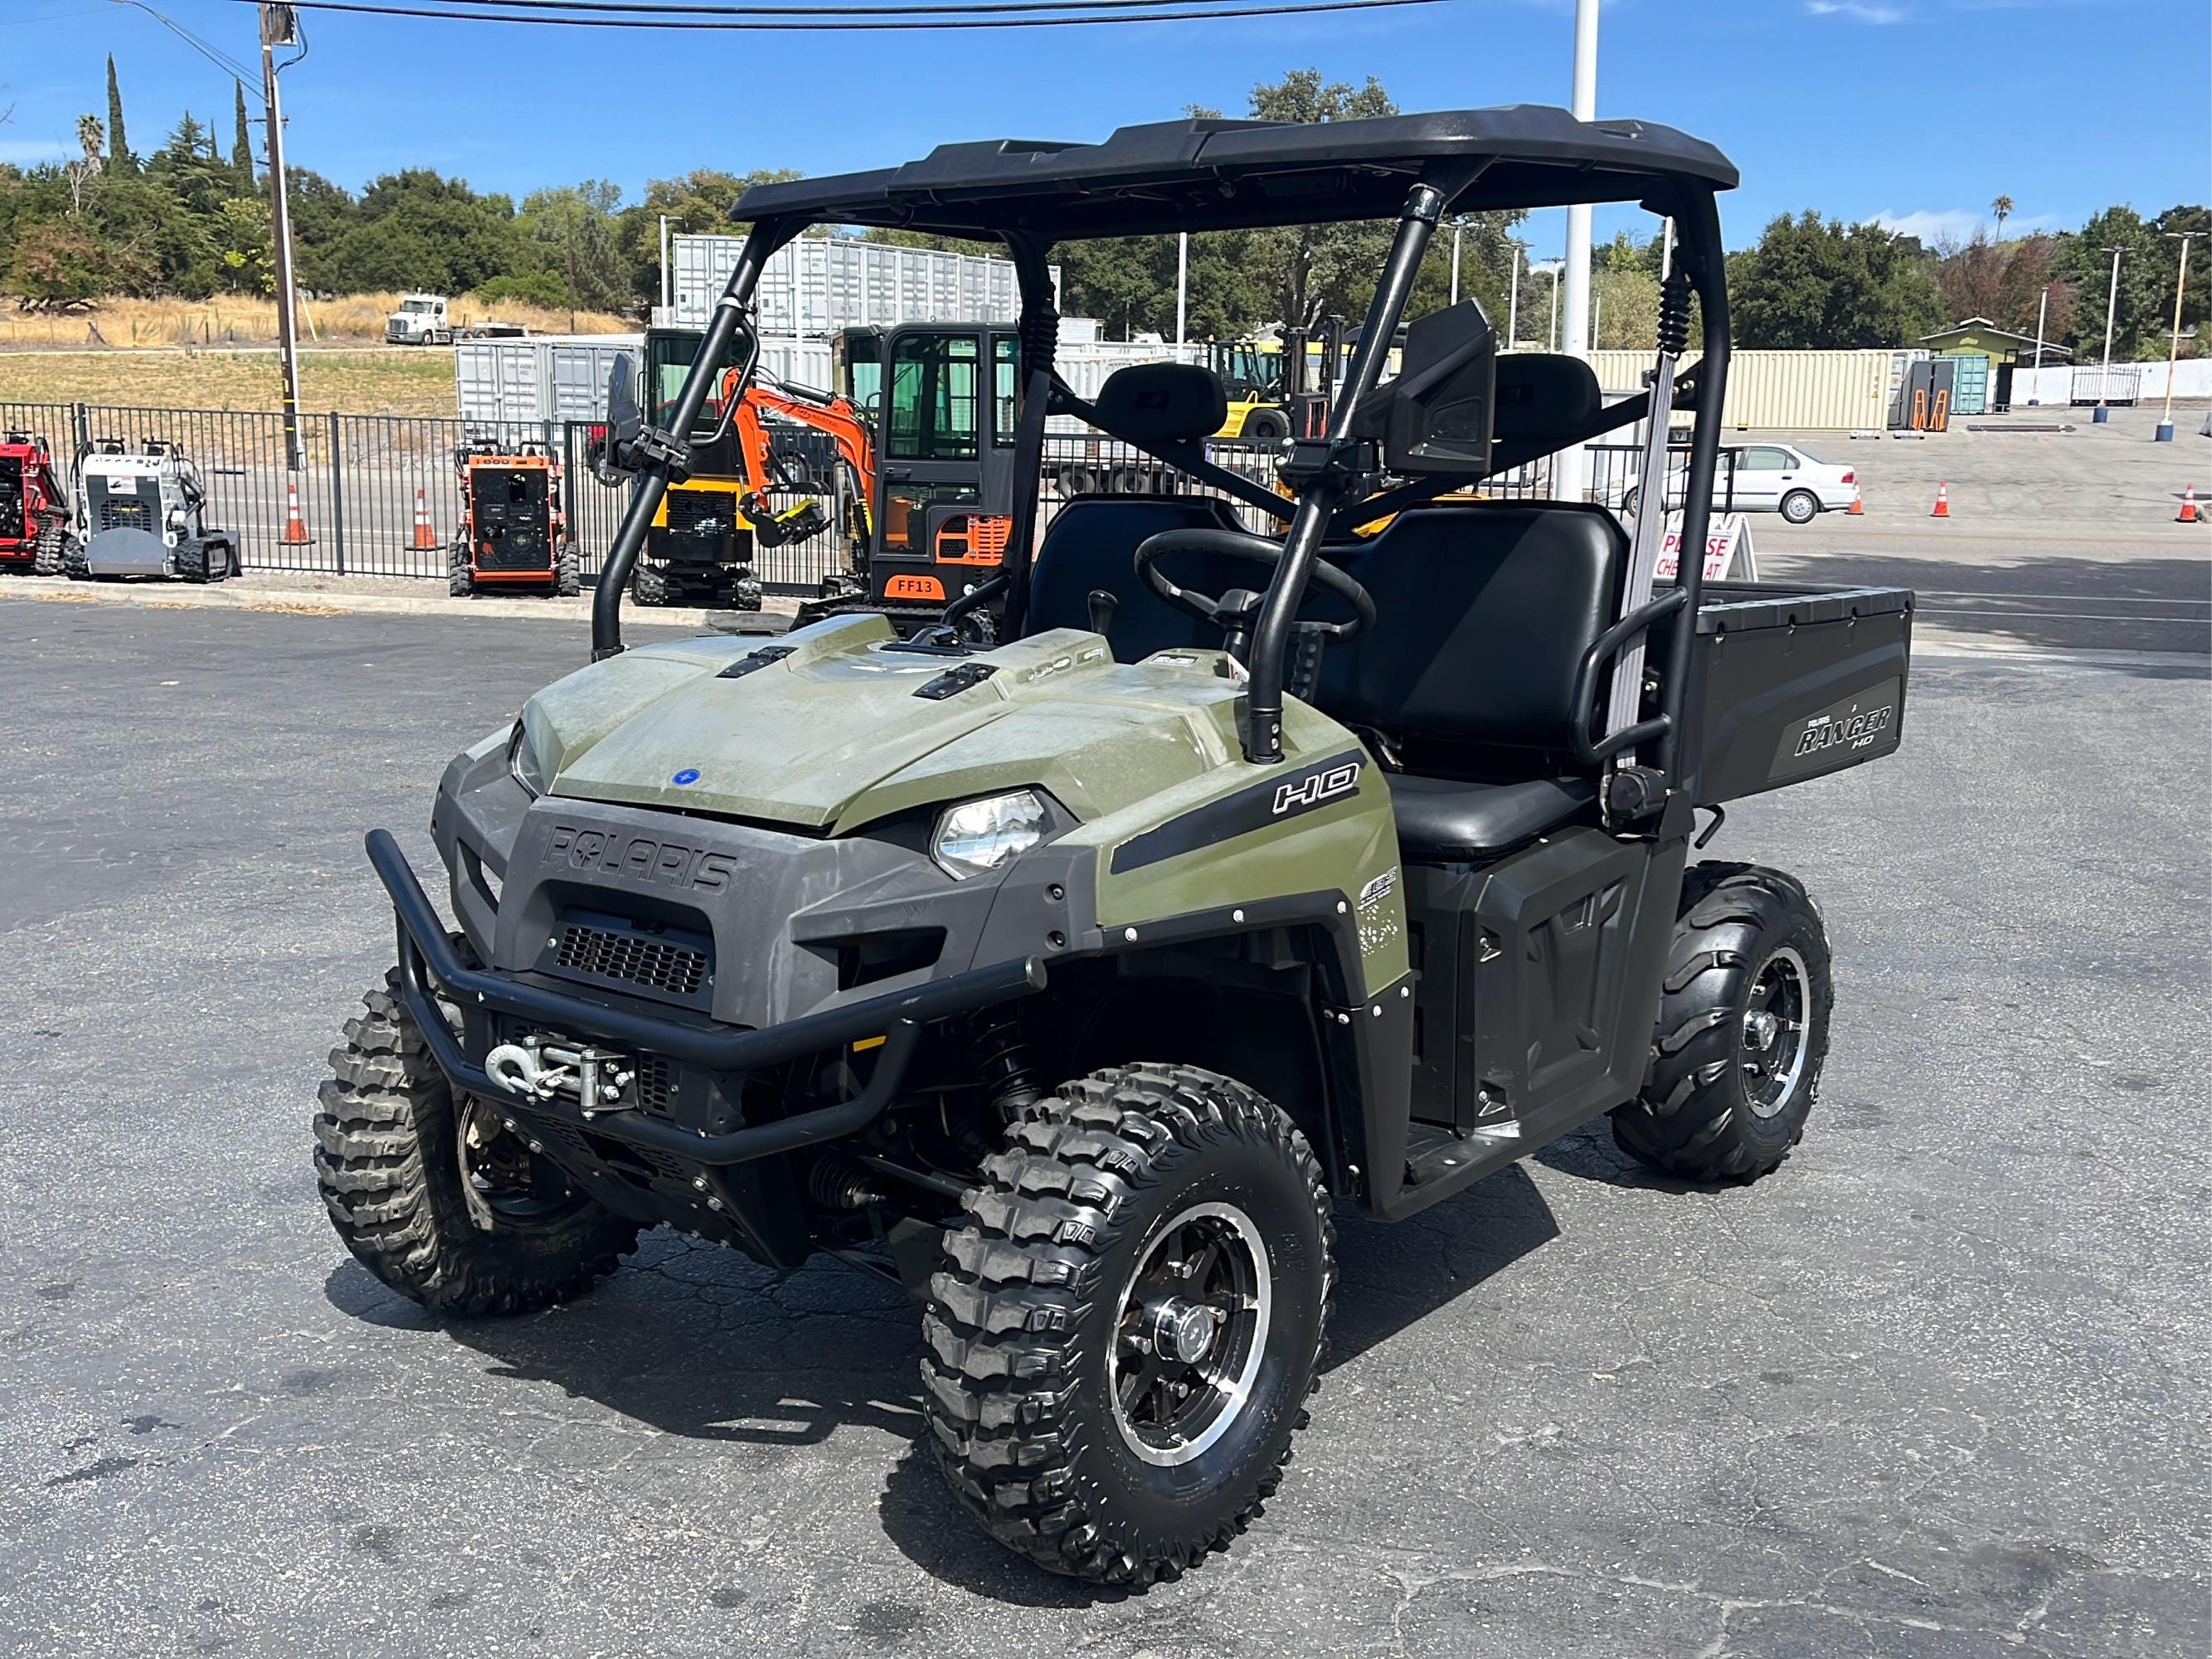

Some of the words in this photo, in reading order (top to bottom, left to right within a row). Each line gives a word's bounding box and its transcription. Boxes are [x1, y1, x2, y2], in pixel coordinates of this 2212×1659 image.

[1662, 535, 1728, 557] PLSE
[898, 580, 932, 592] FF13
[1794, 705, 1892, 757] RANGER
[1851, 735, 1874, 749] HD
[1272, 762, 1360, 815] HD
[542, 826, 737, 896] POLARIS
